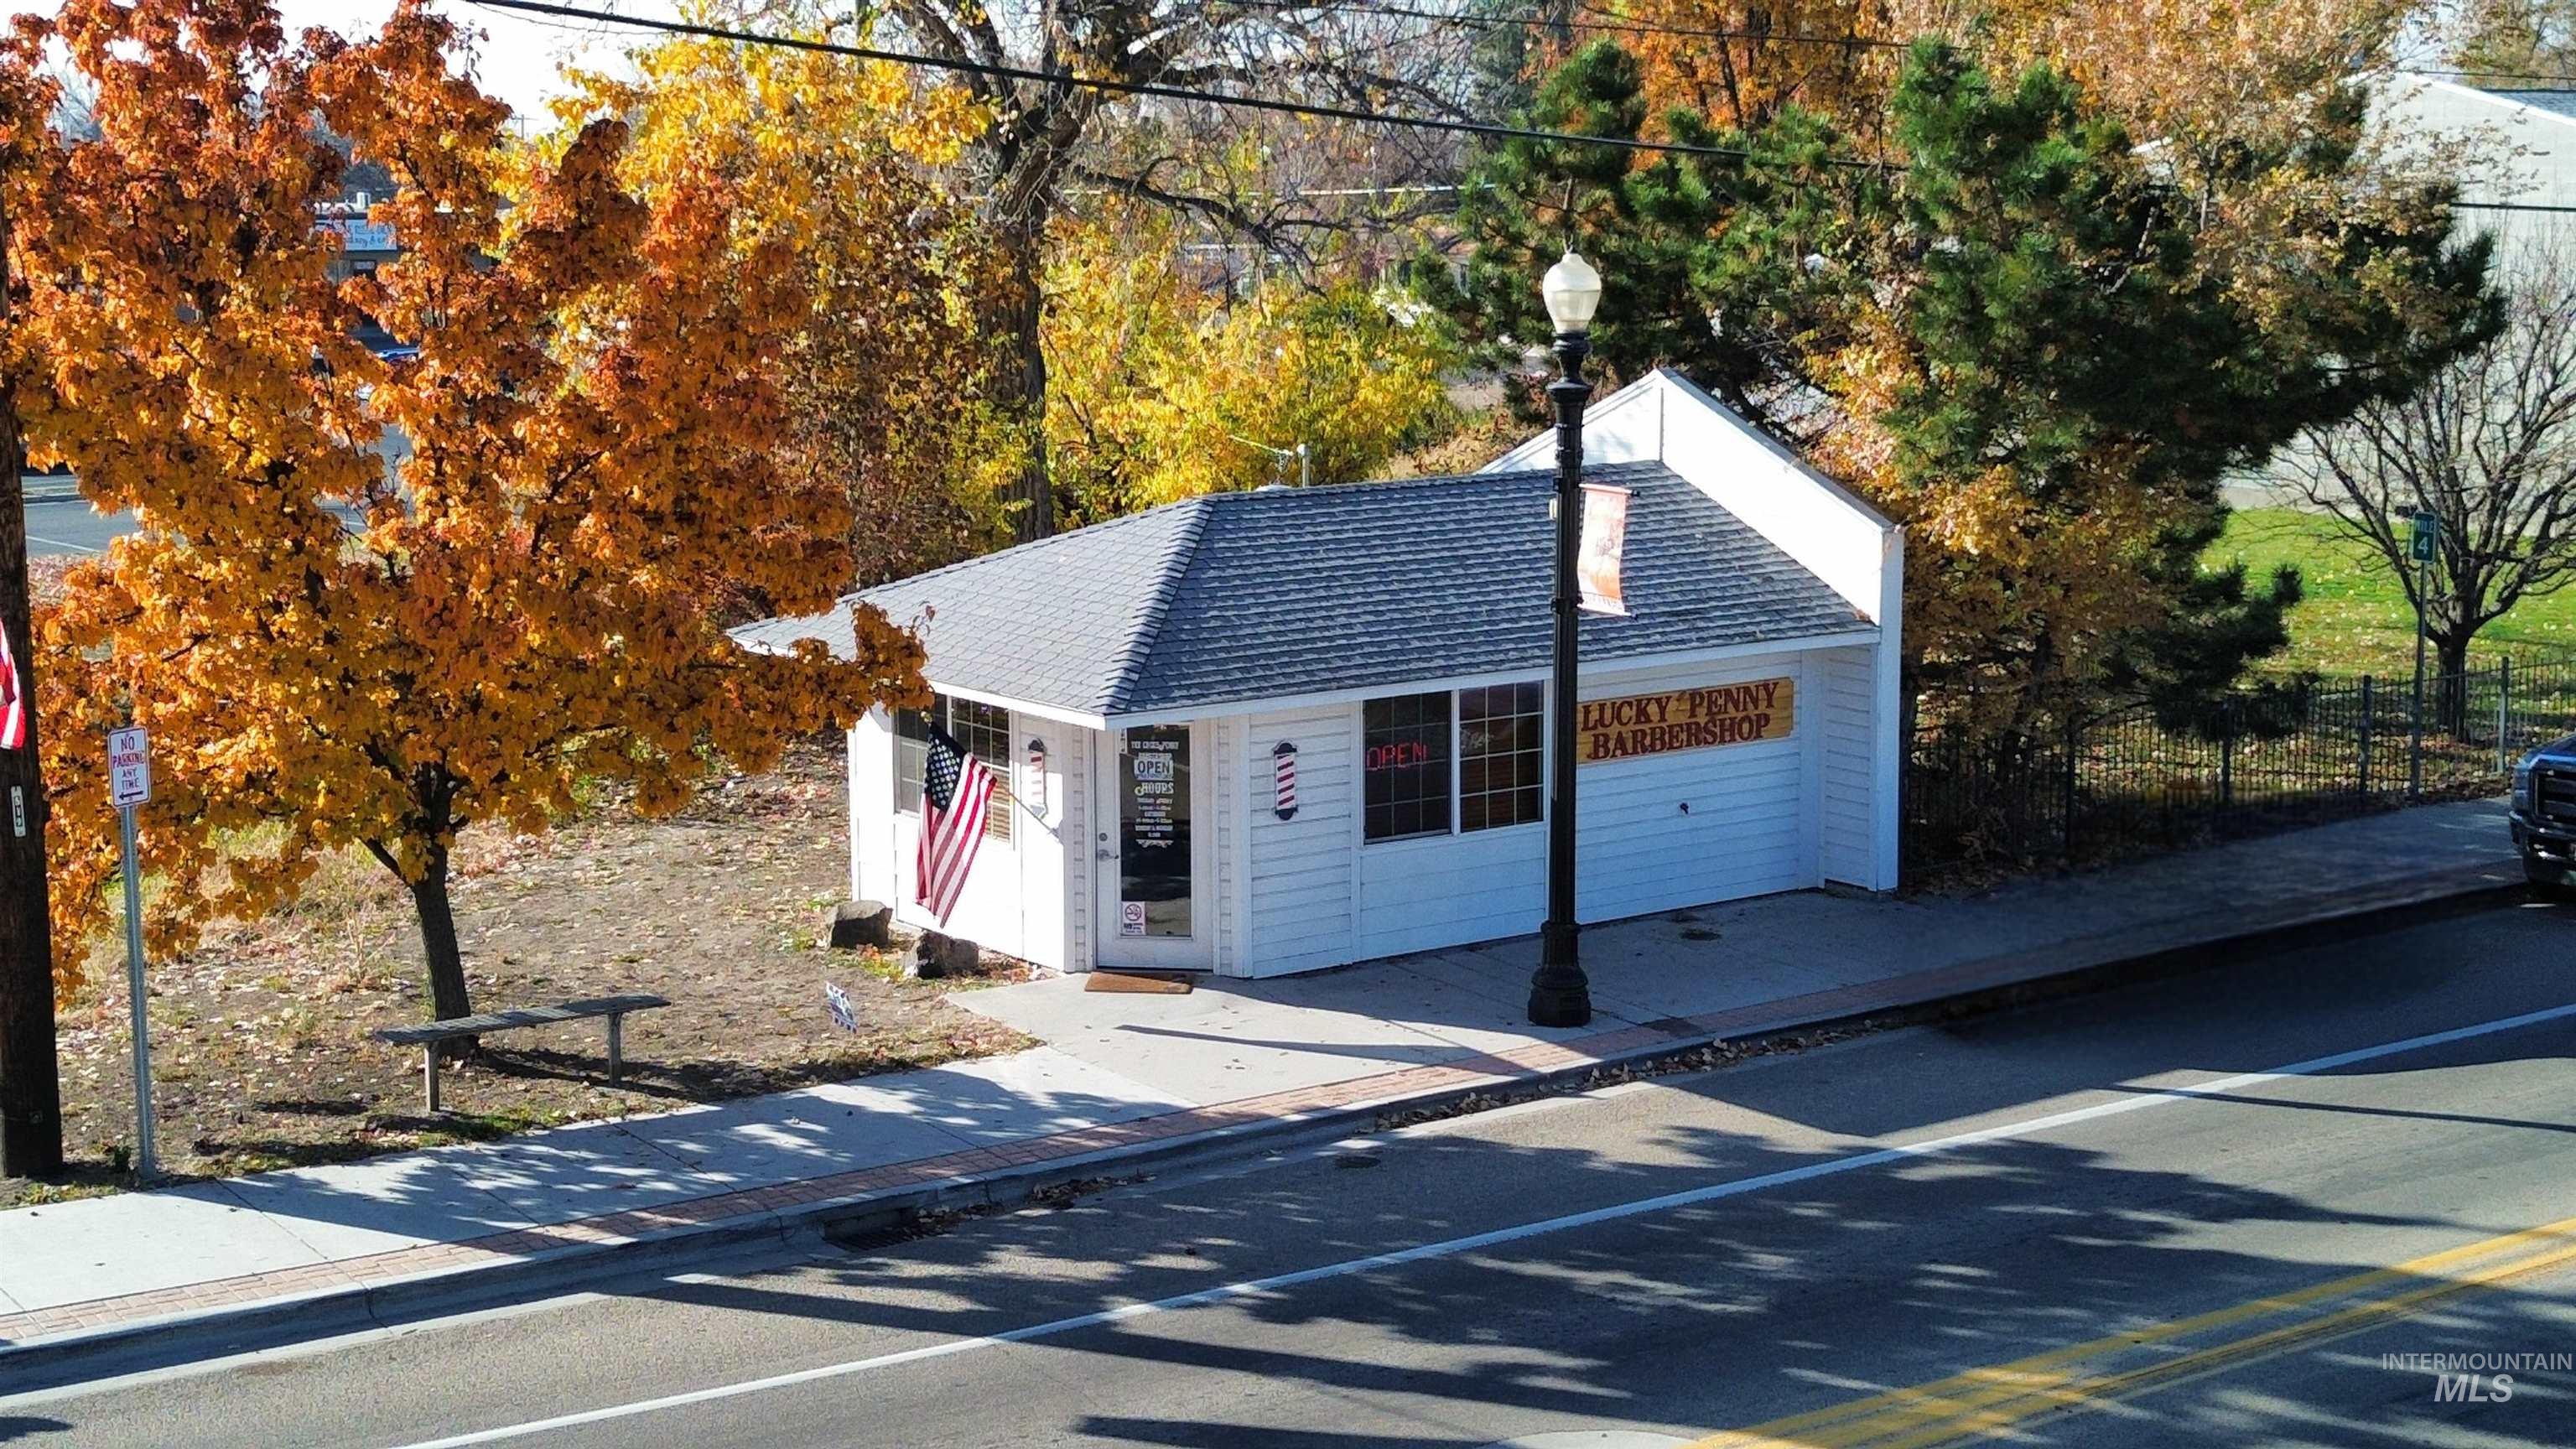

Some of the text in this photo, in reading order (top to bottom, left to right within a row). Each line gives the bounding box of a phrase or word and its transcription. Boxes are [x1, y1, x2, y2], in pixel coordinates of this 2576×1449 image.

[2418, 536, 2428, 554] 4
[1581, 681, 1779, 732] LUCKY PENNY
[120, 736, 135, 751] NO
[1587, 713, 1771, 761] BARBERSHOP
[112, 751, 144, 769] PARKING
[1366, 742, 1428, 771] OPEN
[1137, 760, 1170, 773] OPEN
[1135, 782, 1174, 796] HOURS
